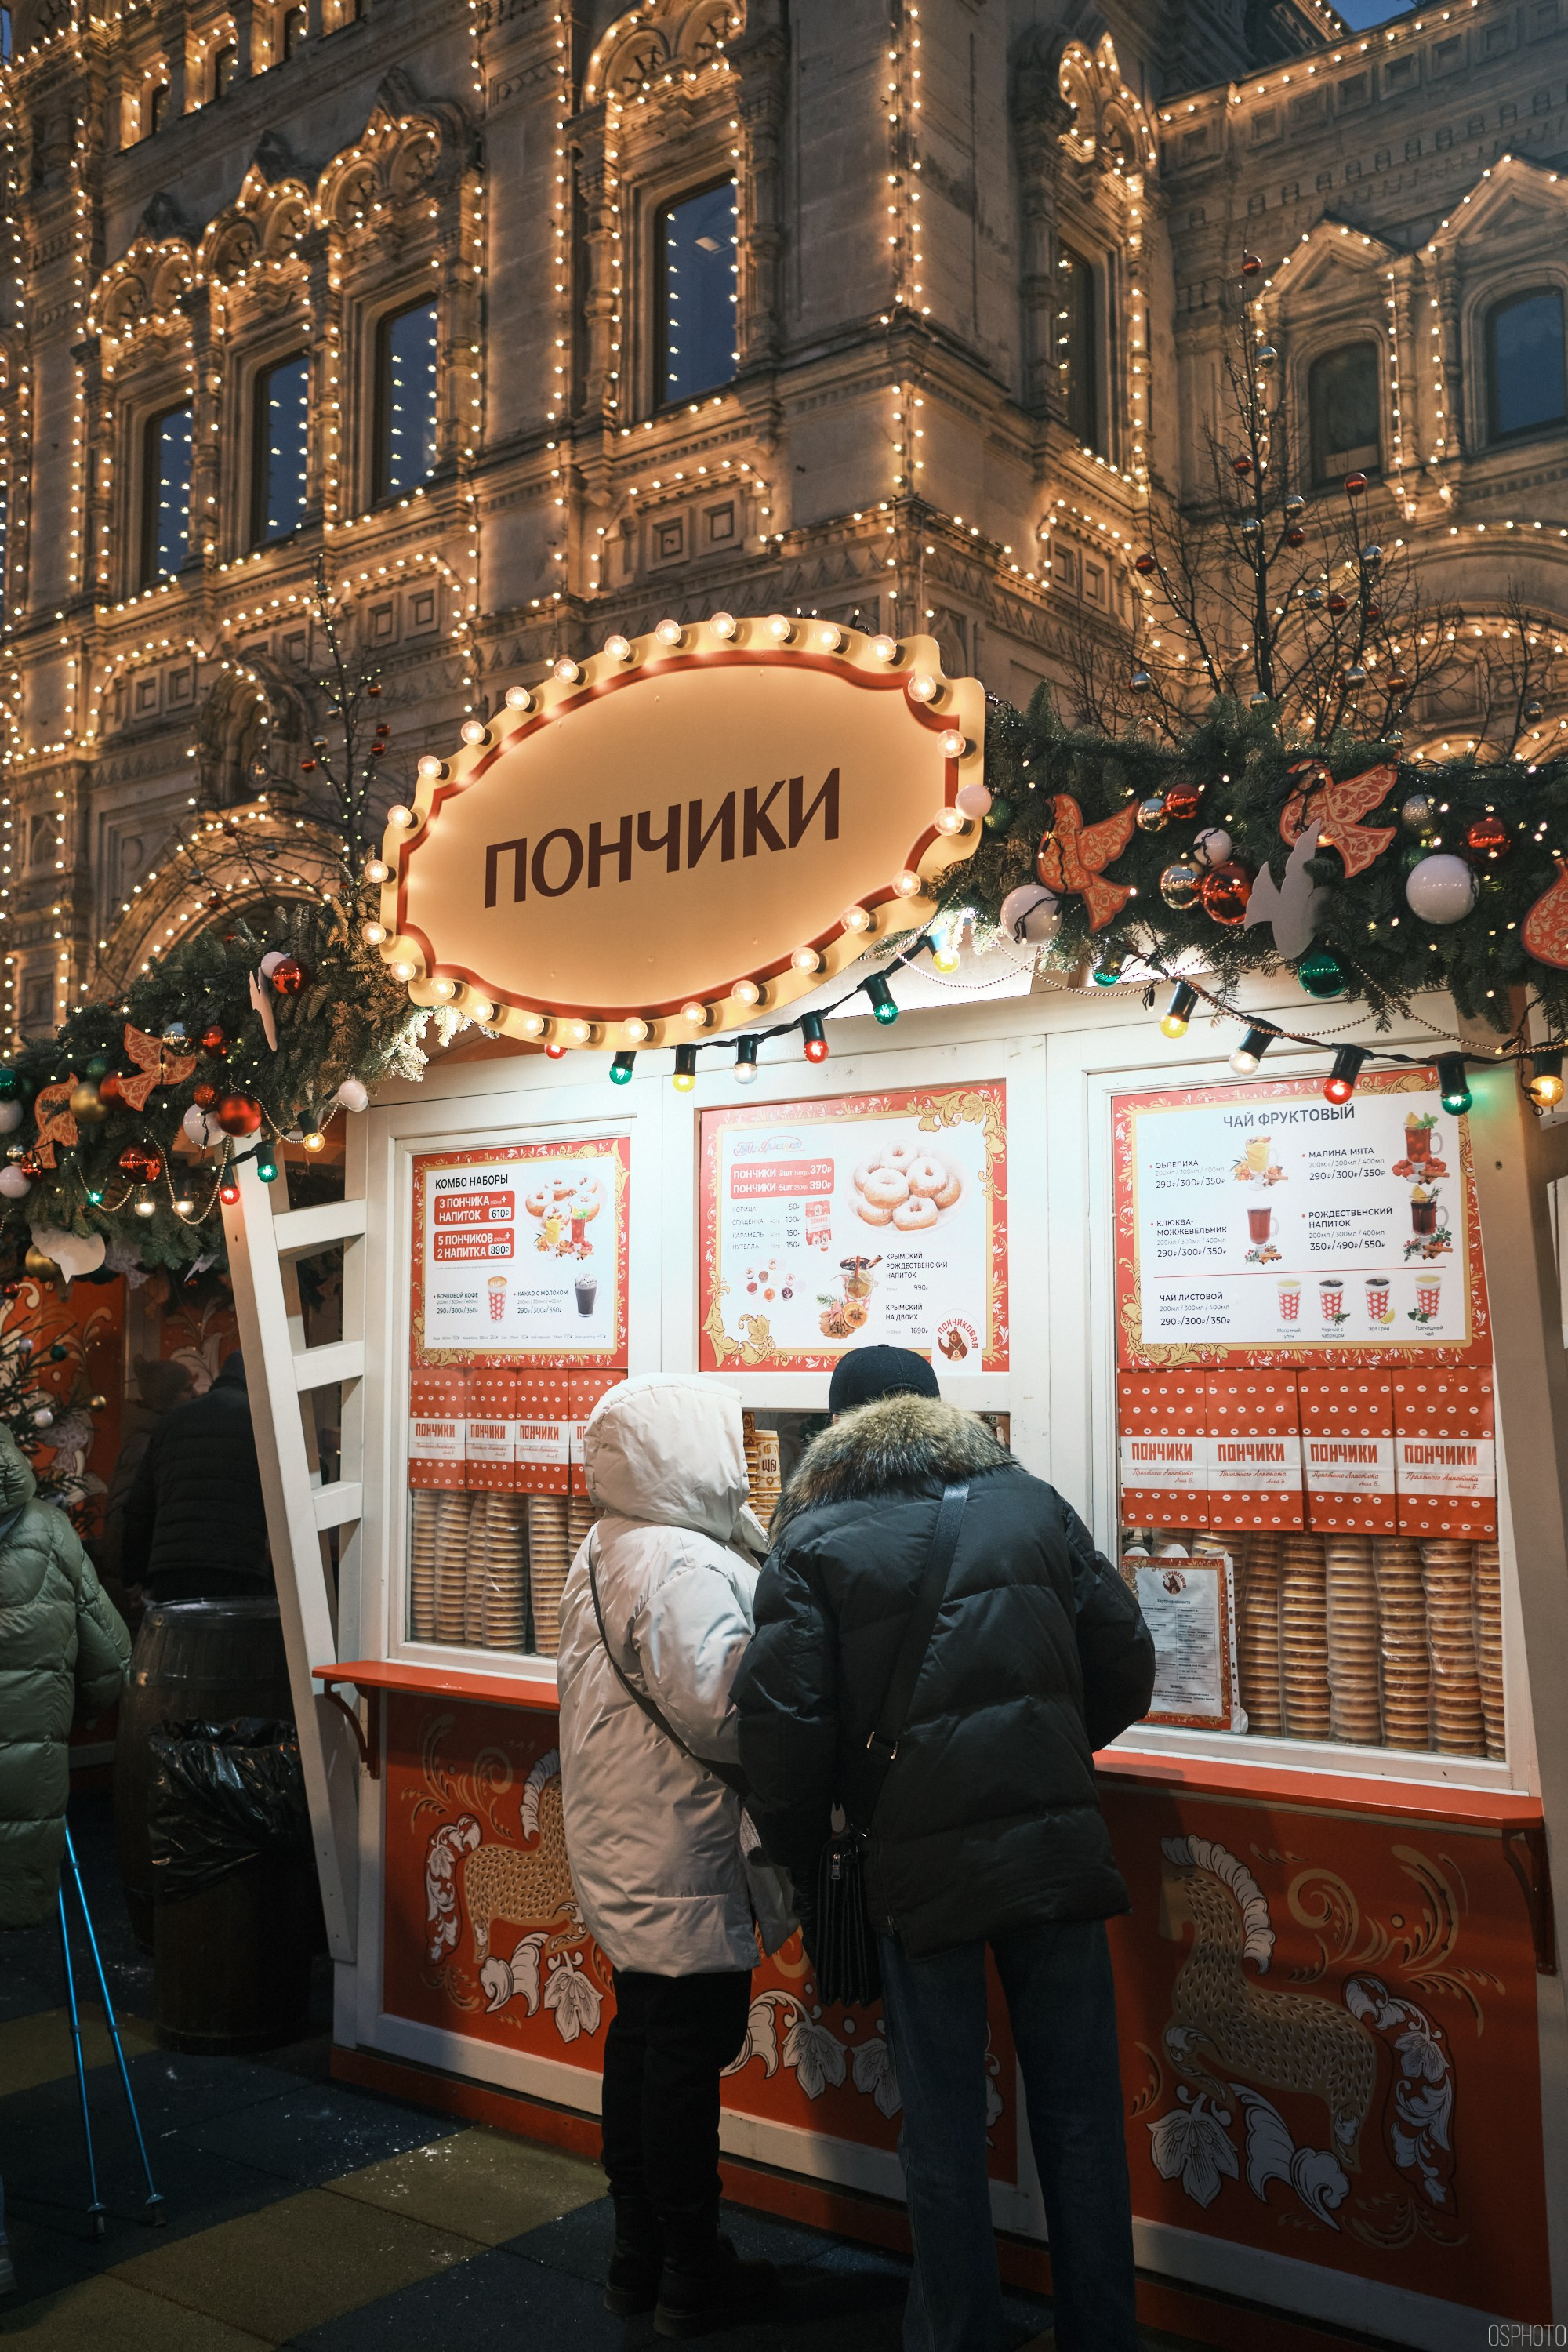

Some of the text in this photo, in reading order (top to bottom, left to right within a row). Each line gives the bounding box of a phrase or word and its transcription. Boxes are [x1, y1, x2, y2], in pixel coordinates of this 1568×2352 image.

[485, 767, 840, 908] ПОНЧИКИ
[1223, 1103, 1355, 1128] ЧАЙ ФРУКТОВЫЙ
[1308, 1147, 1374, 1158] МАЛИНА-МЯТА
[1155, 1160, 1199, 1169] ОБЛЕПИХА
[733, 1168, 776, 1179] ПОНЧИКИ
[810, 1164, 832, 1174] 370₽
[435, 1174, 508, 1189] КОМБО НАБОРЫ
[733, 1182, 776, 1194] ПОНЧИКИ
[809, 1180, 832, 1190] 390₽
[439, 1199, 445, 1208] 3
[447, 1196, 489, 1207] ПОНЧИКА
[439, 1210, 481, 1222] НАПИТОК
[1308, 1206, 1392, 1218] РОЖДЕСТВЕНСКИЙ
[1156, 1218, 1194, 1227] КЛЮКВА-
[1308, 1220, 1351, 1229] НАПИТОК
[1156, 1226, 1227, 1236] МОЖЖЕВЕЛЬНИК
[438, 1236, 444, 1246] 5
[445, 1233, 493, 1245] ПОНЧИКОВ
[437, 1248, 443, 1258] 2
[445, 1247, 486, 1258] НАПИТКА
[886, 1261, 948, 1269] РОЖДЕСТВЕНСКИЙ
[1160, 1291, 1223, 1301] ЧАЙ ЛИСТОВОЙ
[885, 1302, 923, 1311] КРЫМСКИЙ
[937, 1318, 978, 1348] ПОНЧИКОВАЯ
[416, 1423, 456, 1437] ПОНЧИКИ
[470, 1424, 506, 1439] ПОНЧИКИ
[520, 1425, 559, 1440] ПОНЧИКИ
[1131, 1443, 1192, 1461] ПОНЧИКИ
[1218, 1443, 1285, 1461] ПОНЧИКИ
[1310, 1443, 1377, 1463] ПОНЧИКИ
[1404, 1444, 1477, 1465] ПОНЧИКИ
[1132, 1468, 1162, 1476] Приятного
[1312, 1470, 1344, 1479] Приятного
[1405, 1472, 1440, 1481] Приятного
